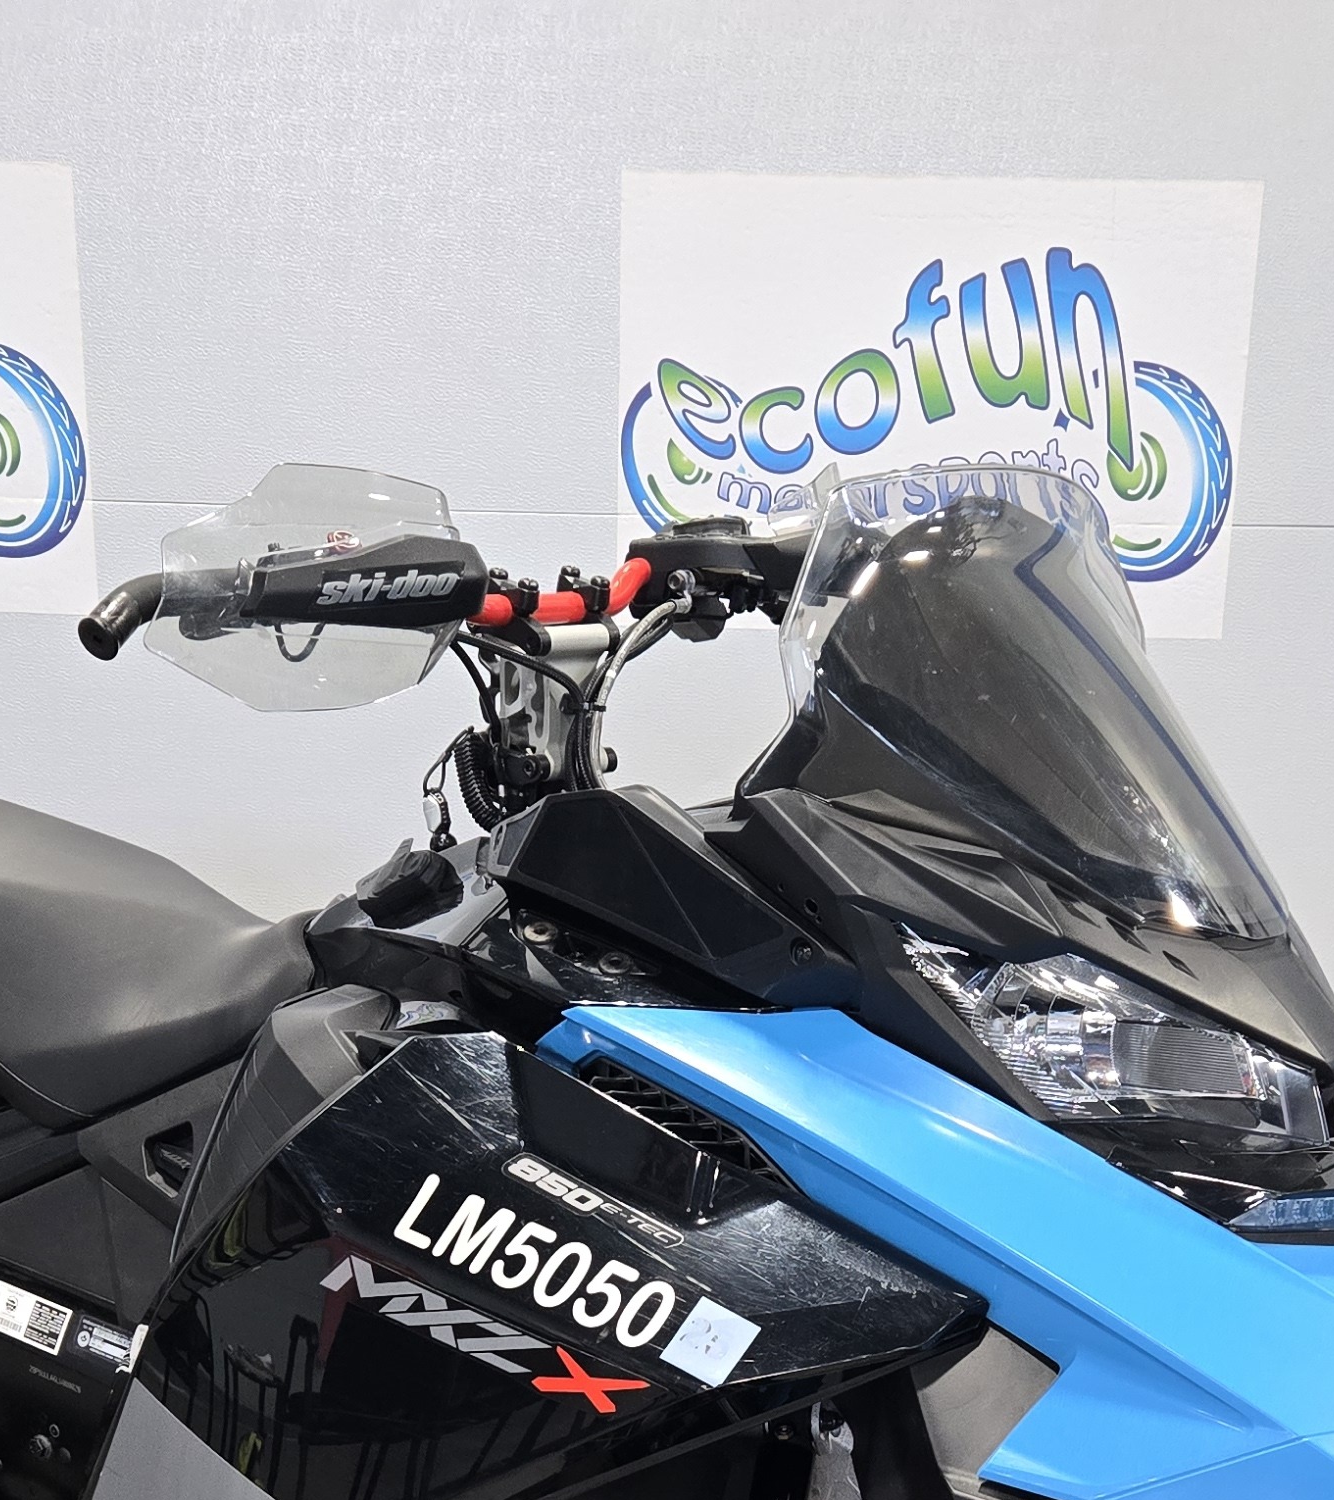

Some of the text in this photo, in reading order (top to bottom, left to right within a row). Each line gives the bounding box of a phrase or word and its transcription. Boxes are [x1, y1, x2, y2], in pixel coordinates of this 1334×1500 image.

[657, 246, 1134, 473] ecofun
[316, 569, 460, 605] ski-doo
[507, 1157, 678, 1244] 850 E-TEC
[393, 1172, 676, 1348] LM5050
[530, 1345, 651, 1414] X
